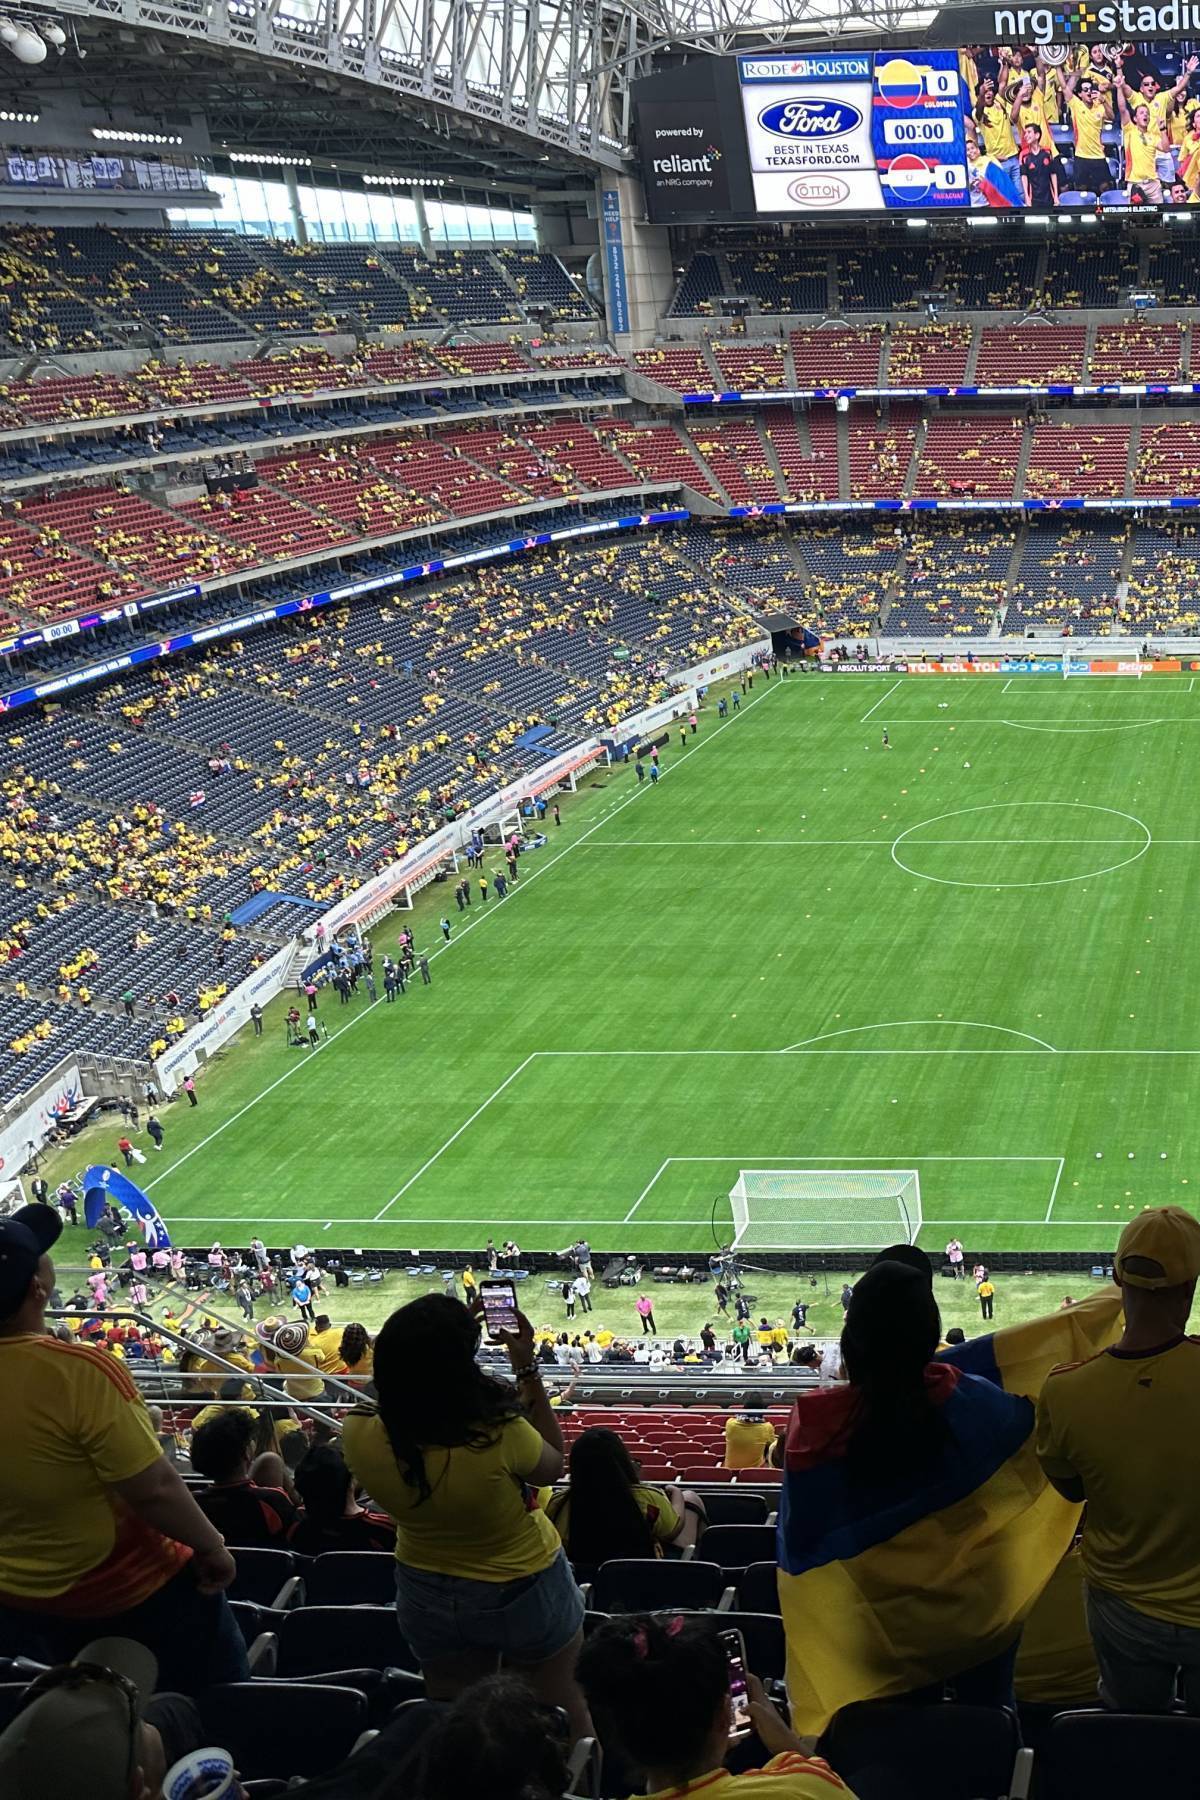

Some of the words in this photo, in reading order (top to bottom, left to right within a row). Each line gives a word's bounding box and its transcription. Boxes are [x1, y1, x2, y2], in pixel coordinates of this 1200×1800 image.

[995, 9, 1053, 44] nrg
[806, 60, 869, 76] HOUSTON
[938, 76, 948, 91] 0
[924, 100, 958, 109] COLOMBIA
[779, 102, 841, 132] Ford
[655, 129, 694, 138] powered
[696, 127, 704, 138] by
[894, 123, 945, 140] 00:00
[774, 146, 800, 155] BEST
[803, 145, 812, 154] IN
[814, 144, 849, 154] TEXAS
[653, 155, 712, 173] reliant
[766, 155, 860, 167] TEXASFORD.COM
[656, 179, 665, 187] an
[666, 178, 682, 187] NRG
[683, 178, 713, 188] company
[945, 171, 956, 185] 0
[795, 182, 841, 199] COTTON
[837, 664, 867, 672] ABSOLUT
[868, 664, 890, 672] SPORT
[911, 663, 935, 672] TCL
[941, 663, 968, 672] TCL
[972, 662, 999, 672] TCL
[164, 1049, 189, 1074] CONMEBOL
